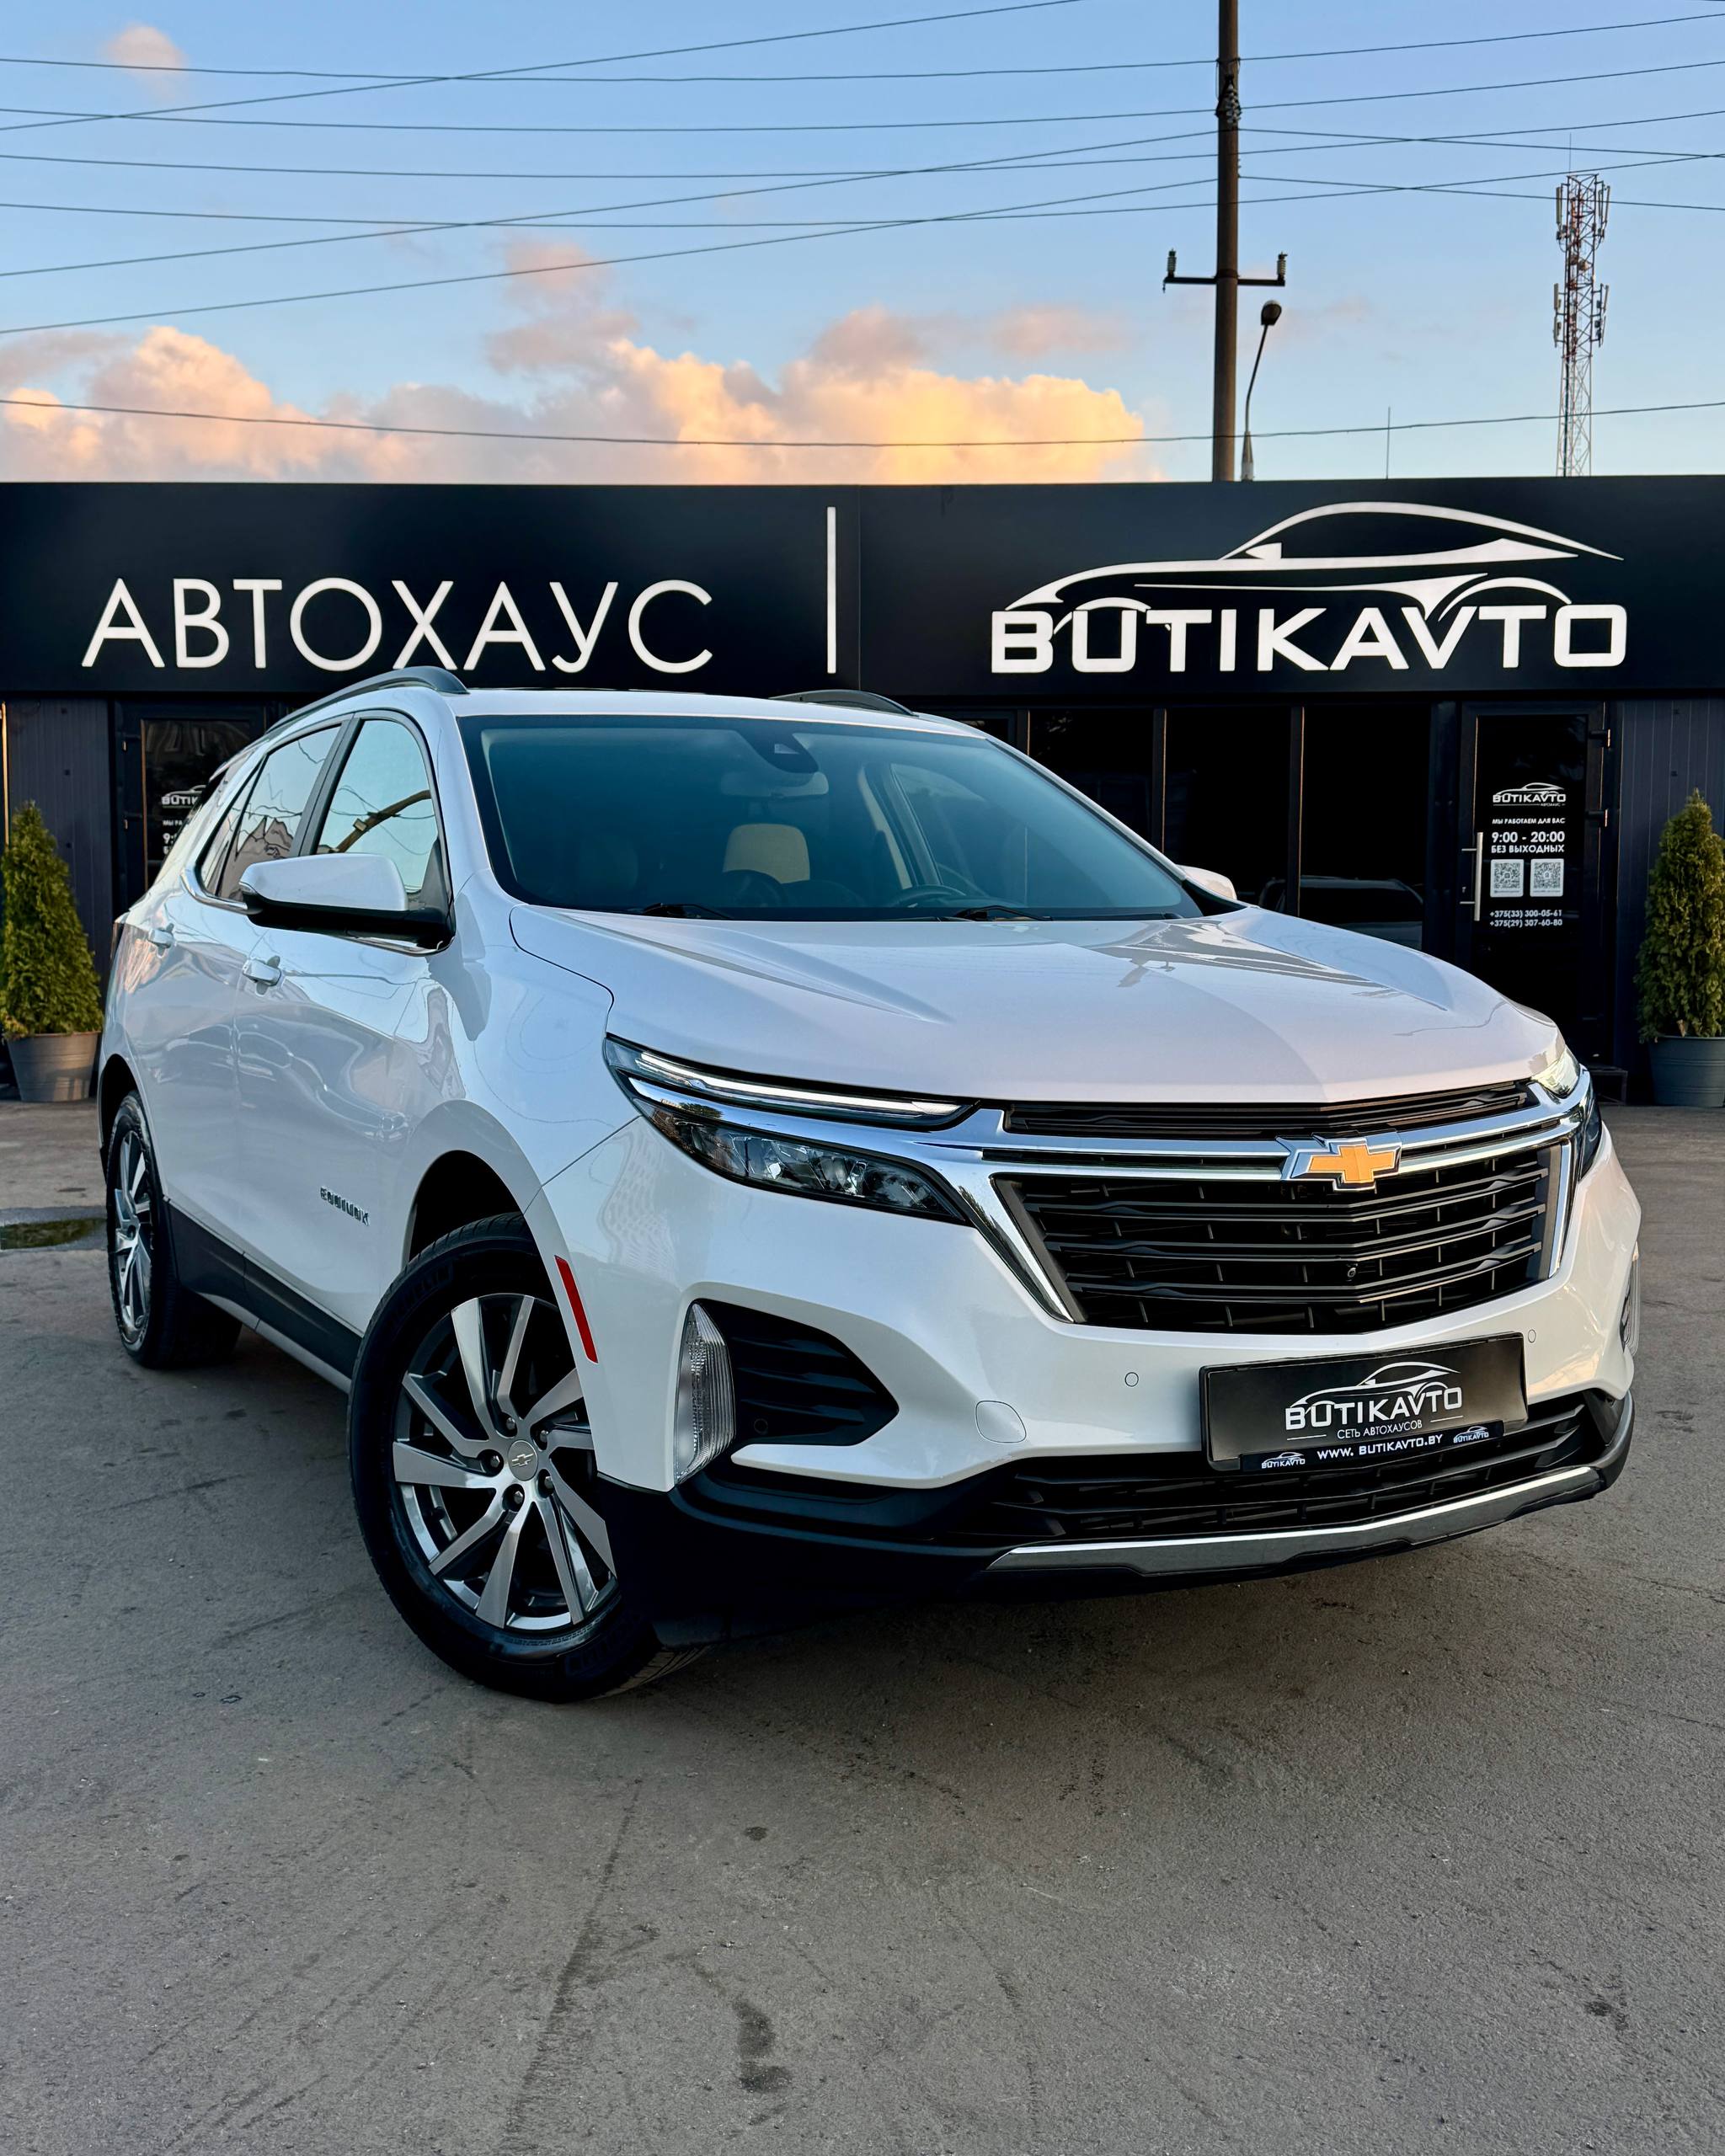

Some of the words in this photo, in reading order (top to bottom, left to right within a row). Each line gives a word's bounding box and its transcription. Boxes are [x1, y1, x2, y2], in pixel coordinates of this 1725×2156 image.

[81, 577, 713, 675] АВТОХАУС
[991, 602, 1627, 675] BUTIKAVTO
[162, 796, 198, 805] BUTIK
[1493, 793, 1567, 803] BUTIKAVTO
[1492, 832, 1518, 843] 9:00
[1530, 831, 1565, 842] 20:00
[1491, 845, 1506, 853] БЕЗ
[1509, 844, 1565, 854] ВЫХОДНЫХ
[1489, 910, 1524, 919] +375(33)
[1525, 909, 1562, 917] 300-05-61
[1489, 919, 1524, 928] +375(29)
[1525, 919, 1563, 927] 307-60-80
[1284, 1386, 1463, 1430] BUTIKAVTO
[1337, 1428, 1361, 1439] СЕТЬ
[1363, 1419, 1423, 1437] АВТОХАУСОВ
[1453, 1432, 1490, 1444] BUTIKAVTO
[1316, 1447, 1354, 1460] WWW.
[1359, 1434, 1444, 1456] BUTIKAVTO.BY
[1261, 1458, 1306, 1469] BUTIKAVTO
